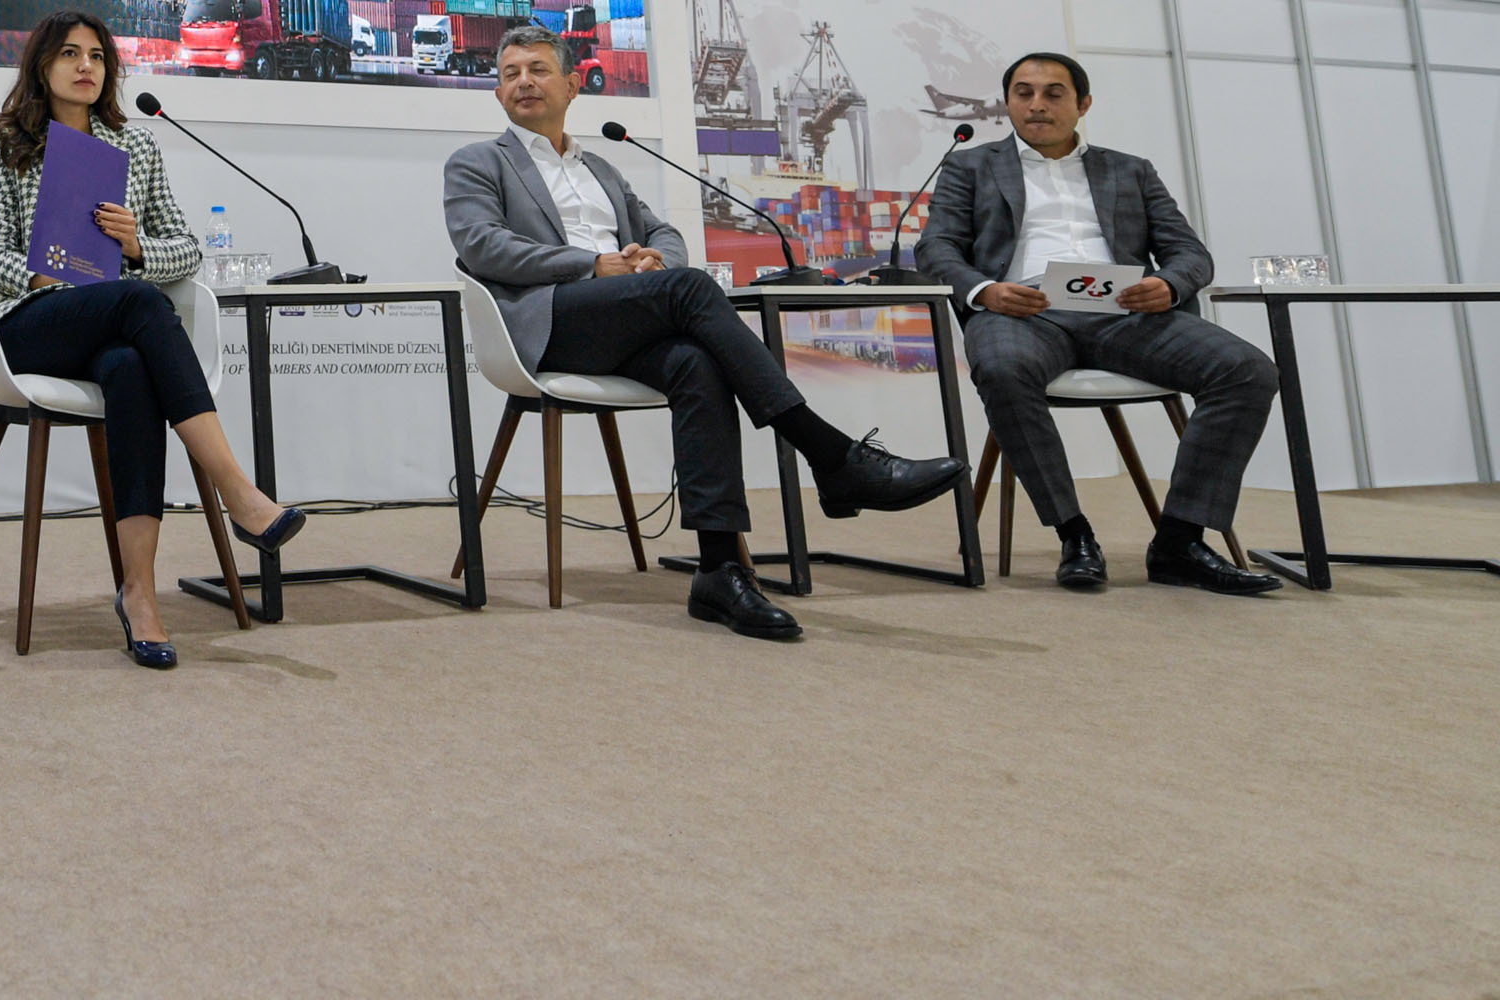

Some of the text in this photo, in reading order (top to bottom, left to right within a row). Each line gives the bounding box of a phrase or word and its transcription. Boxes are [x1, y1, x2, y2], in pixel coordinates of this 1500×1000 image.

[272, 341, 308, 355] RLİĞİ)
[312, 342, 394, 354] DENETİMİNDE
[229, 364, 245, 375] OF
[314, 364, 338, 374] AND
[340, 362, 412, 374] COMMODITY
